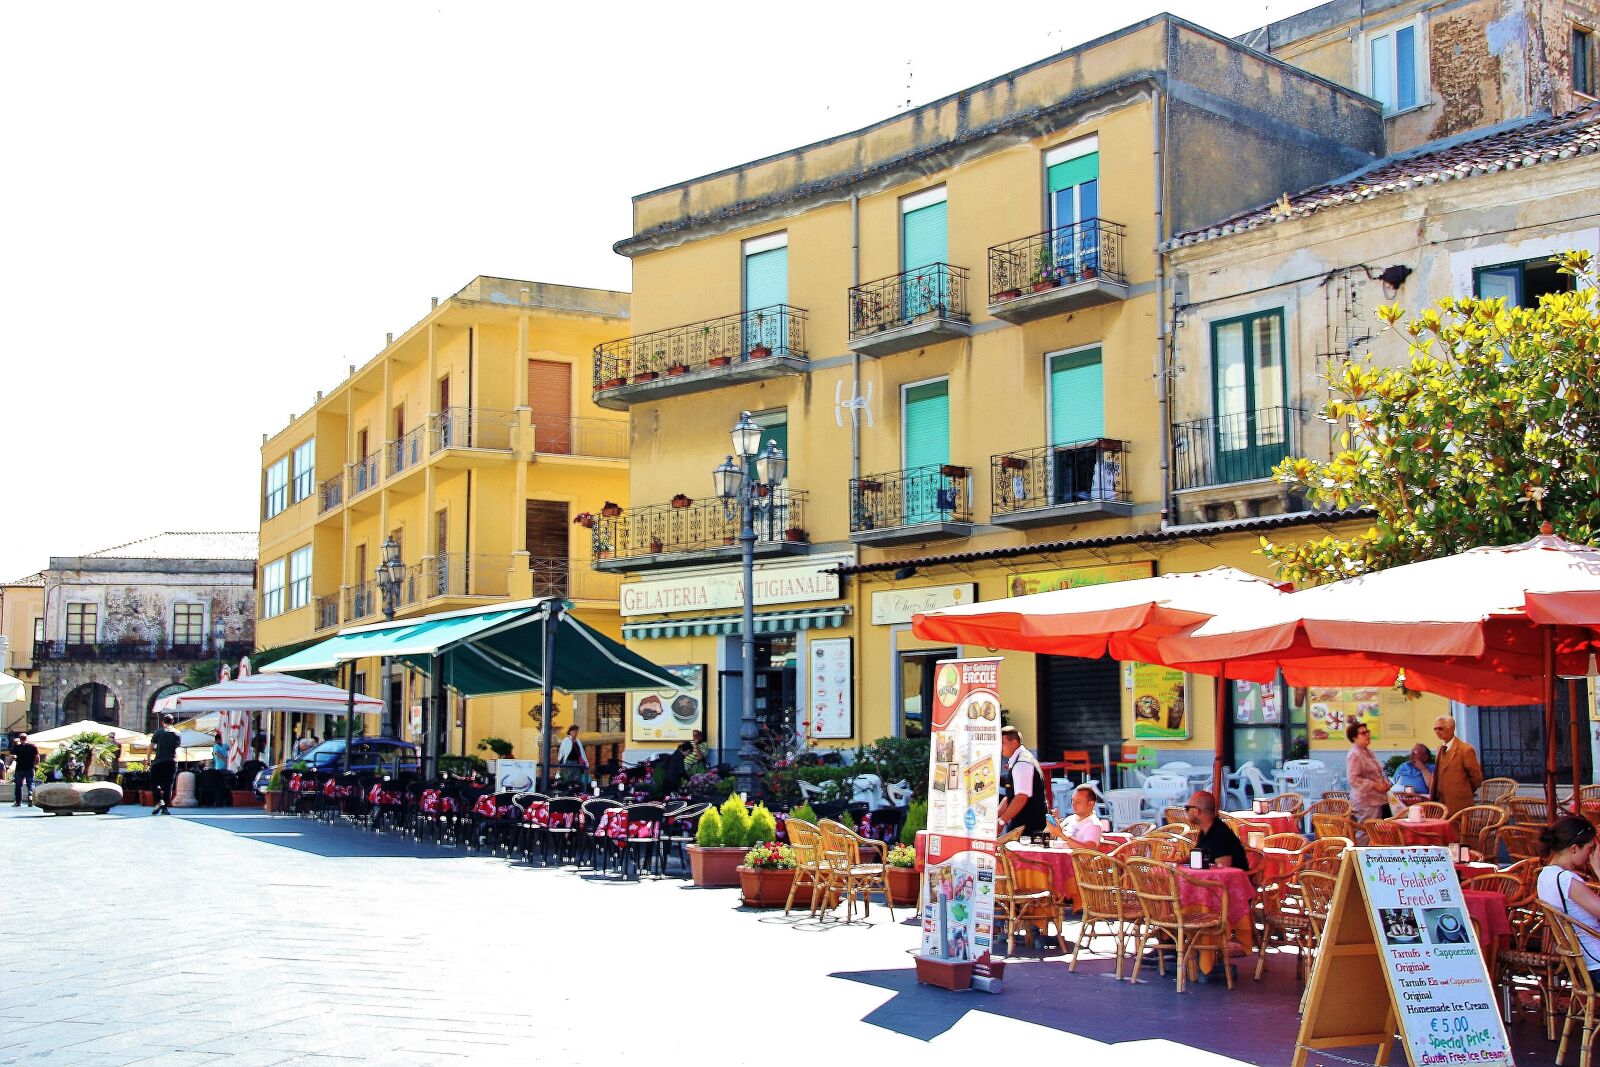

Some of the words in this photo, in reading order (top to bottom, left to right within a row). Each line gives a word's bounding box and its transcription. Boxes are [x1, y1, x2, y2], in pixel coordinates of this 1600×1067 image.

[624, 585, 708, 611] GELATERIA
[735, 573, 835, 601] ATIGIANALE
[962, 672, 997, 684] ERCOLE
[1365, 853, 1406, 863] Produzione
[1408, 853, 1446, 864] Artigianale
[1378, 867, 1397, 886] Bar
[1401, 869, 1446, 888] Gelateria
[1391, 949, 1420, 958] Tartufo
[1433, 948, 1476, 959] Cappuccino
[1395, 962, 1430, 974] Originale
[1399, 978, 1426, 987] Tartufo
[1427, 977, 1438, 986] Eis
[1403, 991, 1432, 1002] Original
[1407, 1003, 1451, 1014] Homemade
[1452, 1002, 1464, 1012] Ice
[1465, 1001, 1490, 1011] Cream
[1442, 1016, 1469, 1034] 5,00
[1429, 1033, 1467, 1052] Special
[1467, 1028, 1490, 1046] Price
[1422, 1052, 1447, 1064] Gluten
[1449, 1052, 1466, 1062] Free
[1480, 1050, 1505, 1060] Cream
